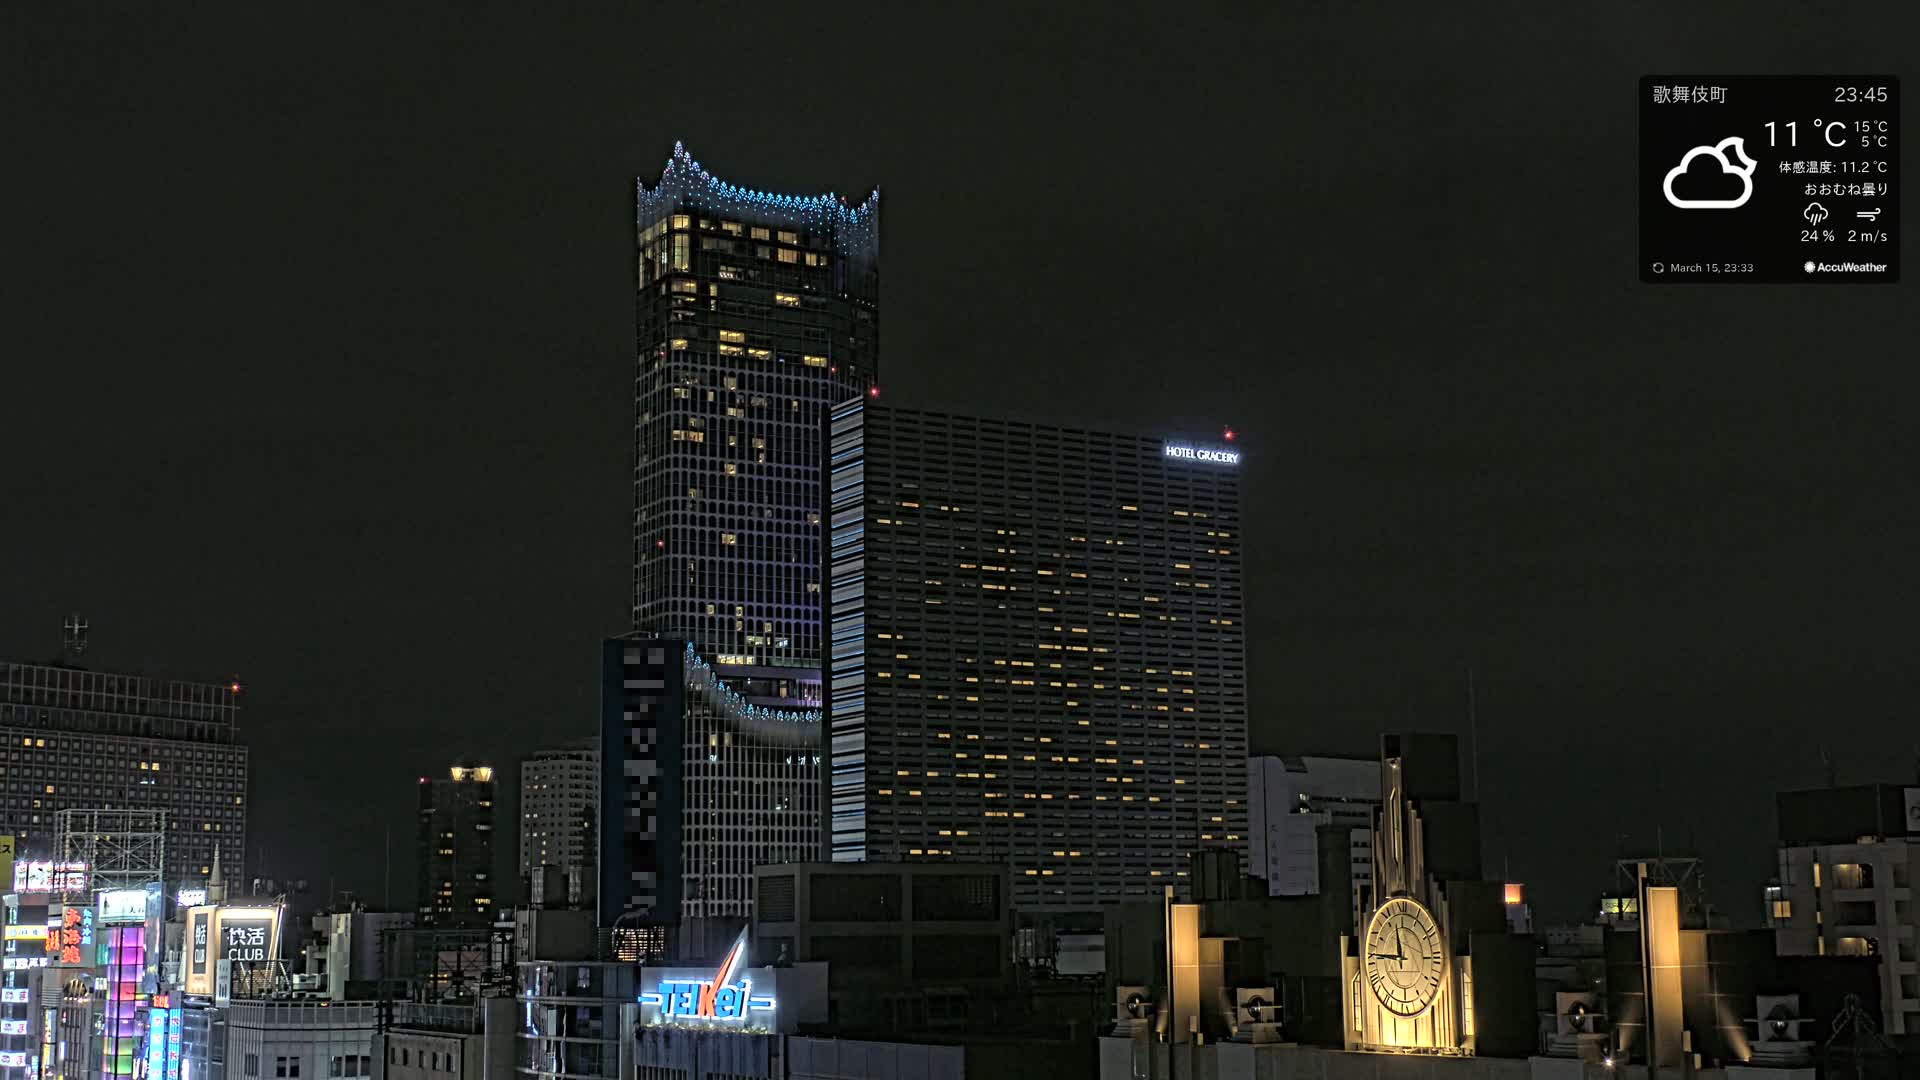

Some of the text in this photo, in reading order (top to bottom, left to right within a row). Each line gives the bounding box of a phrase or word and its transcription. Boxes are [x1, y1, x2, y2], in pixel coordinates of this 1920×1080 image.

[1165, 445, 1240, 464] HOTEL GRACERY
[229, 927, 265, 946] 快活
[228, 948, 264, 961] CLUB
